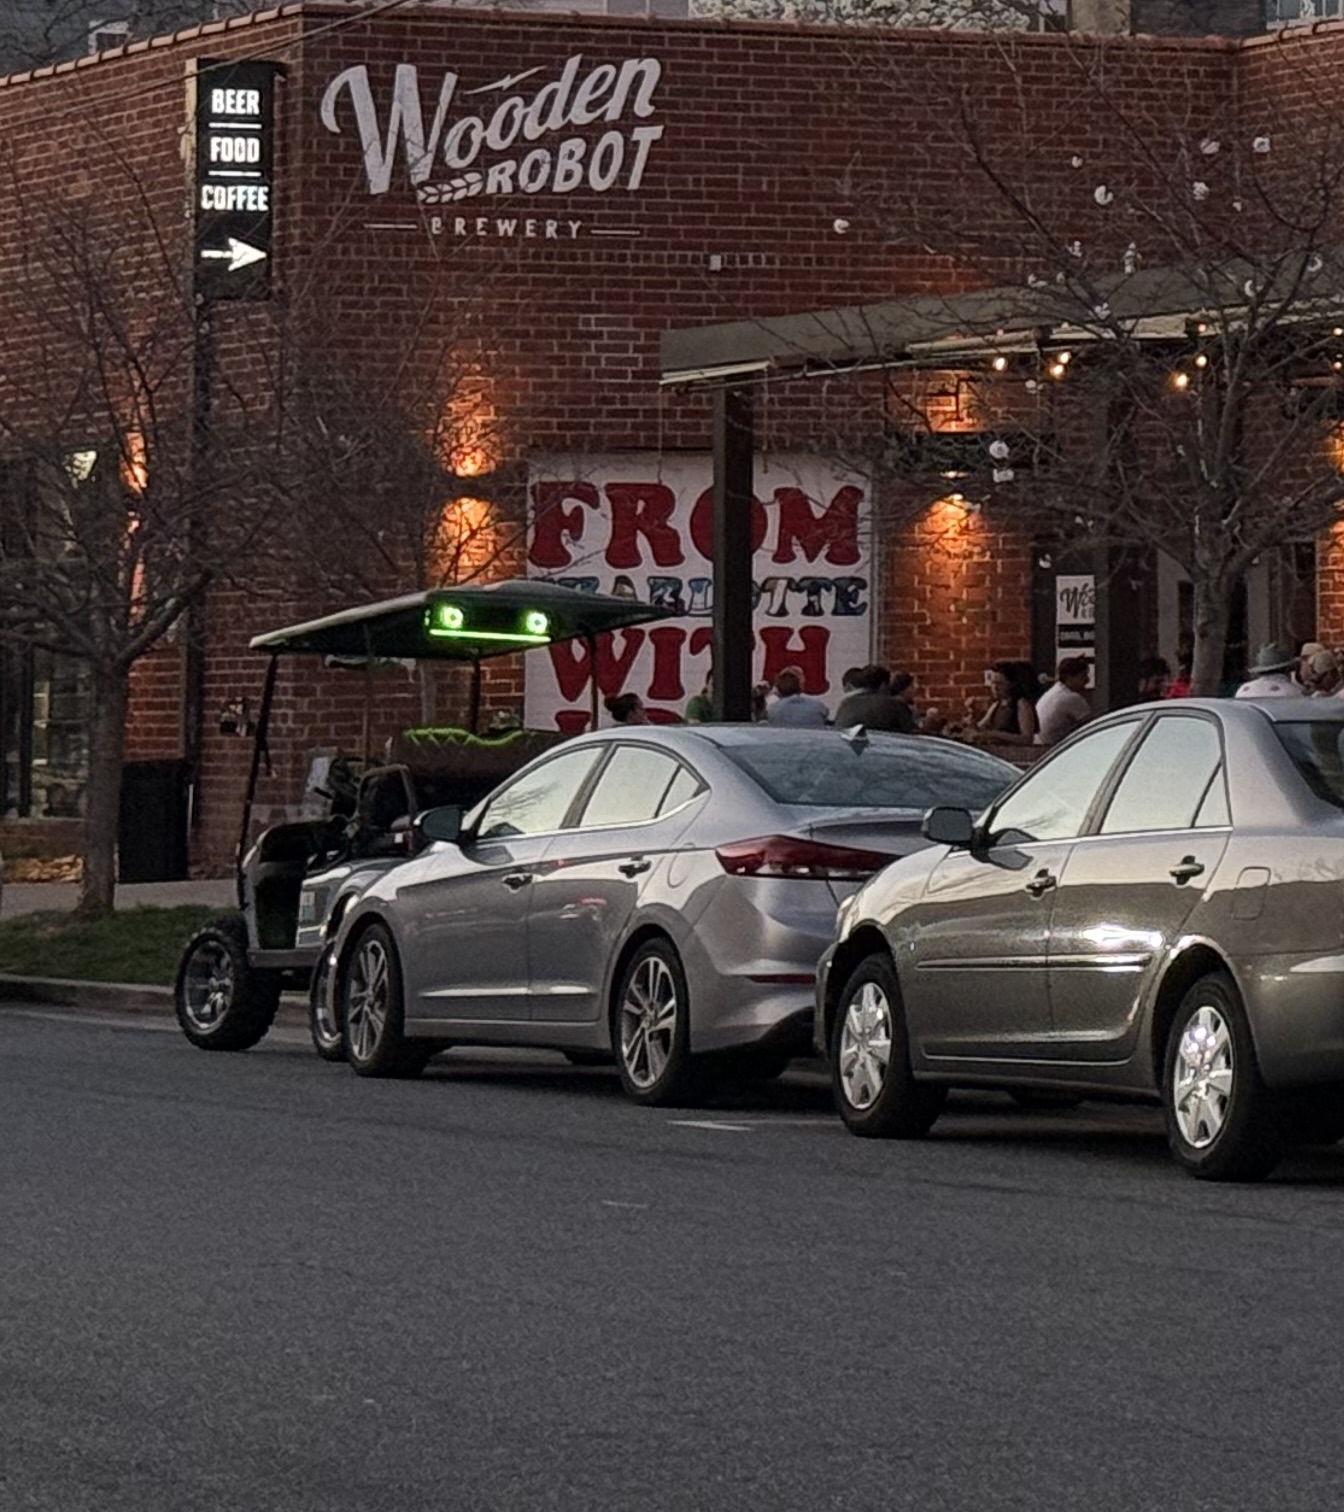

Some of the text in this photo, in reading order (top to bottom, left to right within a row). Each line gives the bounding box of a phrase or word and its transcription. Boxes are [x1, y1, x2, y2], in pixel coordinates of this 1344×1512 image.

[211, 89, 260, 116] BEER
[320, 53, 663, 195] Wooden
[210, 137, 260, 164] FOOD
[484, 125, 665, 195] ROBOT
[201, 184, 269, 212] COFFEE
[431, 217, 583, 239] BREWERY
